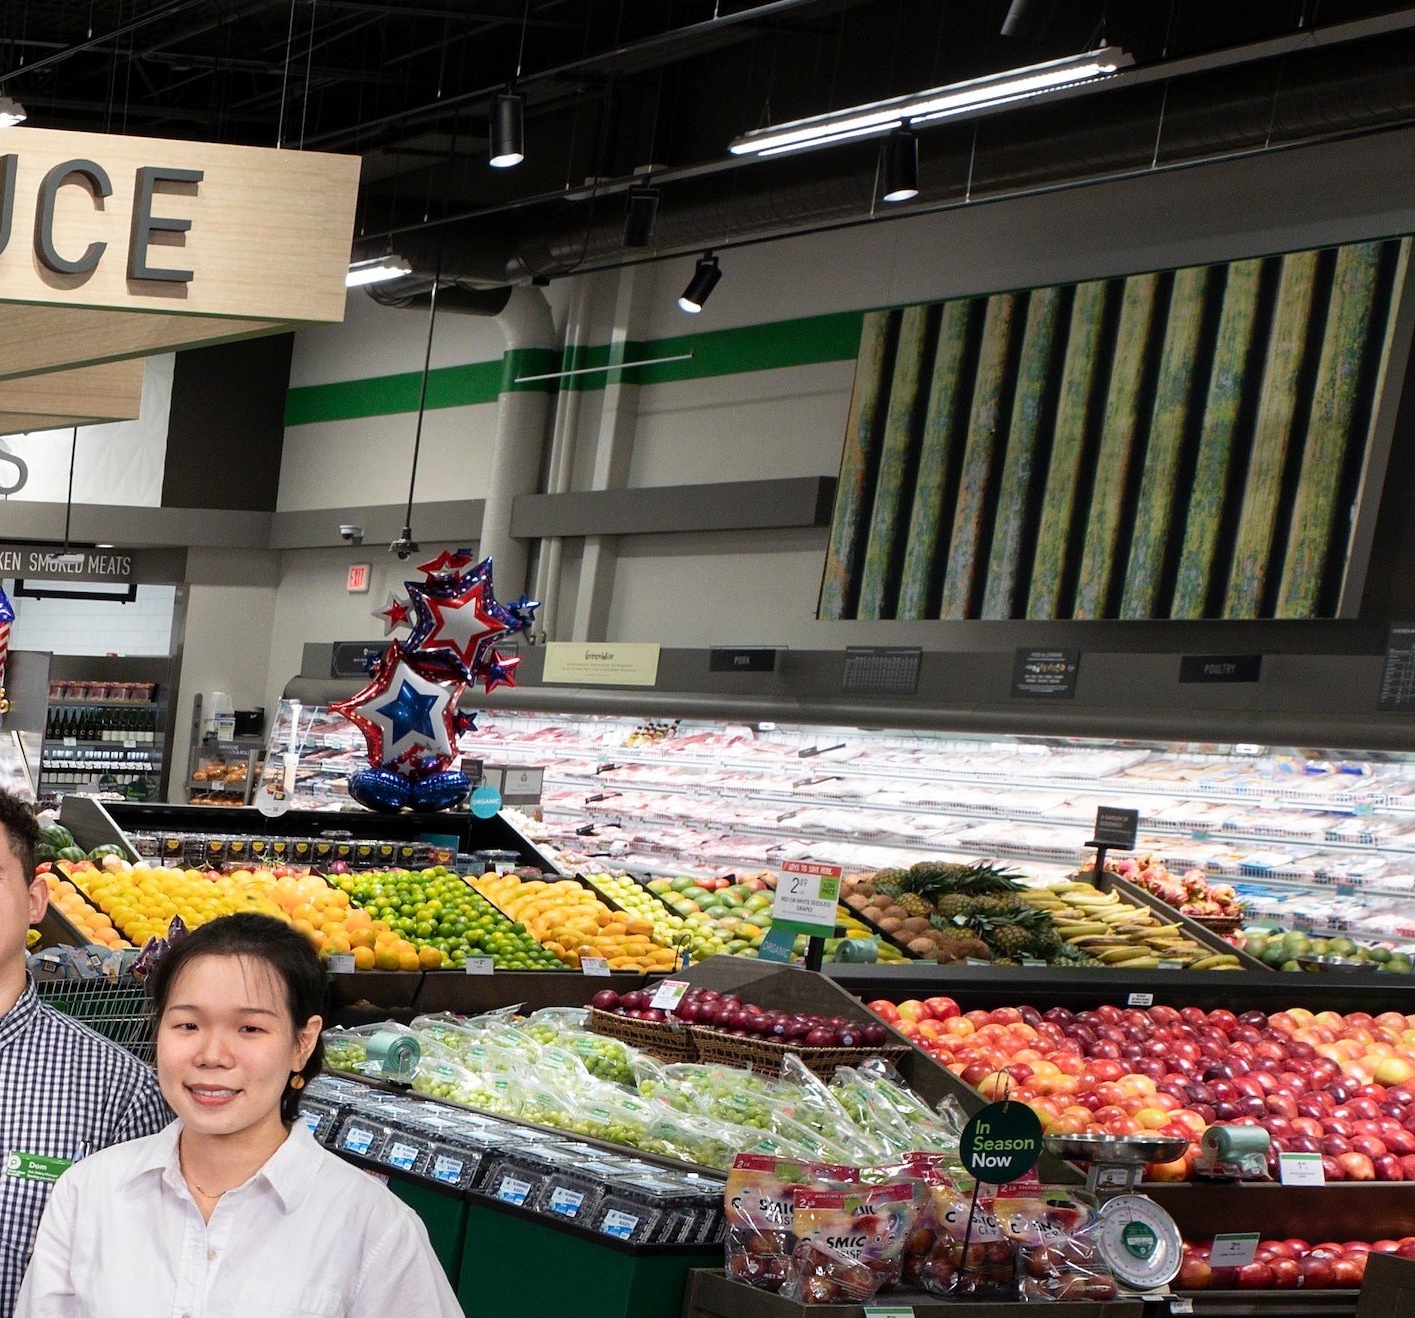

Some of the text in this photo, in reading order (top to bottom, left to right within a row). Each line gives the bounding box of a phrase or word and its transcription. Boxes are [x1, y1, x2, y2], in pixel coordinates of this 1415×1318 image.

[88, 555, 131, 576] MEATS
[347, 567, 366, 588] EXIT
[734, 655, 751, 665] PORK
[1204, 663, 1236, 674] POULTRY
[762, 941, 790, 959] ORGANIC
[975, 1119, 990, 1134] In
[973, 1136, 1035, 1151] Season
[28, 1160, 47, 1171] Dom
[737, 1160, 743, 1168] 2
[972, 1152, 1013, 1168] Now
[1001, 1184, 1008, 1192] 2
[799, 1198, 807, 1207] 2
